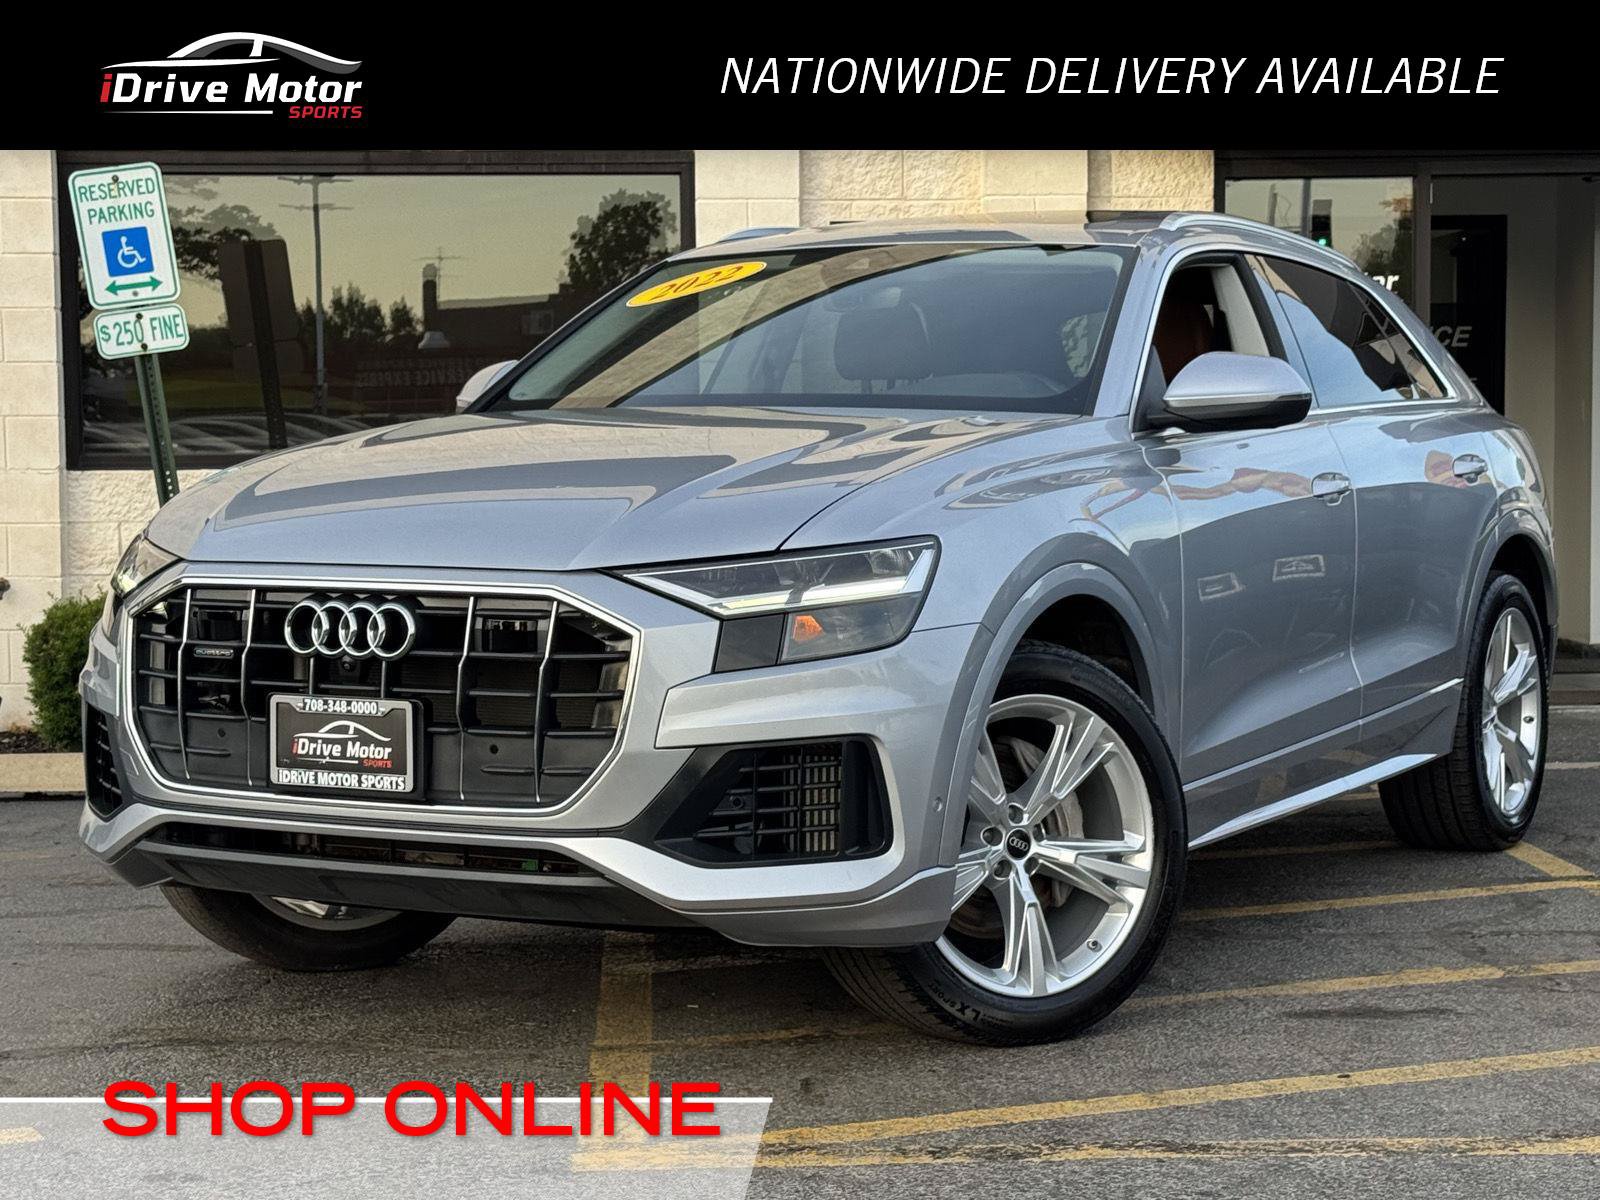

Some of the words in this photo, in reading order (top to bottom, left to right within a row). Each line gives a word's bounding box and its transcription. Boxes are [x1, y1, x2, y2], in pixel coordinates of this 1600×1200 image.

[78, 177, 156, 203] RESERVED
[87, 201, 156, 225] PARKING
[648, 265, 743, 301] 2022
[100, 320, 144, 346] $250
[150, 314, 184, 341] FINE
[304, 698, 378, 715] 708-348-0000
[291, 737, 342, 757] iDrive
[346, 740, 392, 760] Motor
[363, 758, 393, 769] SPORTS
[317, 771, 359, 788] MOTOR
[361, 773, 405, 791] SPORTS
